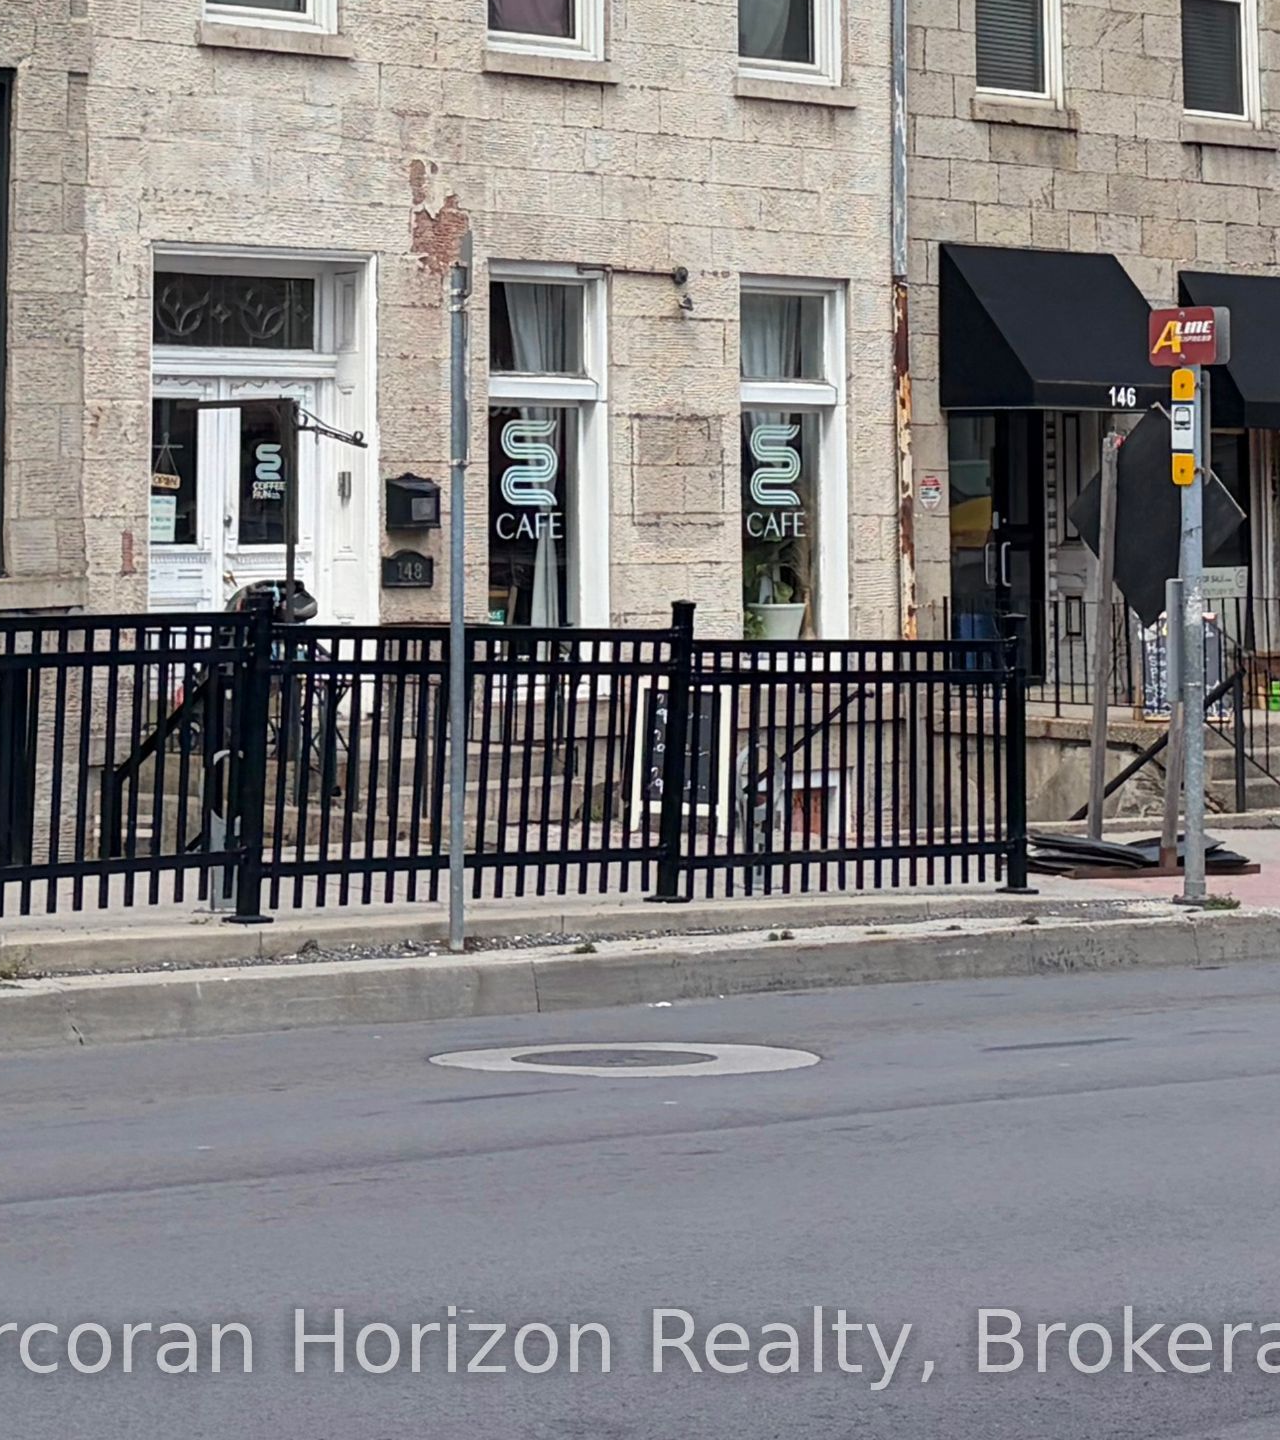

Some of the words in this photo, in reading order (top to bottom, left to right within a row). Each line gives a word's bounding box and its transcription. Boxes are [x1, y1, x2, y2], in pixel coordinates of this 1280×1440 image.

[1151, 320, 1181, 354] A
[1108, 386, 1137, 408] 146
[496, 512, 564, 539] CAFE
[746, 511, 807, 537] CAFE
[397, 561, 423, 580] 148
